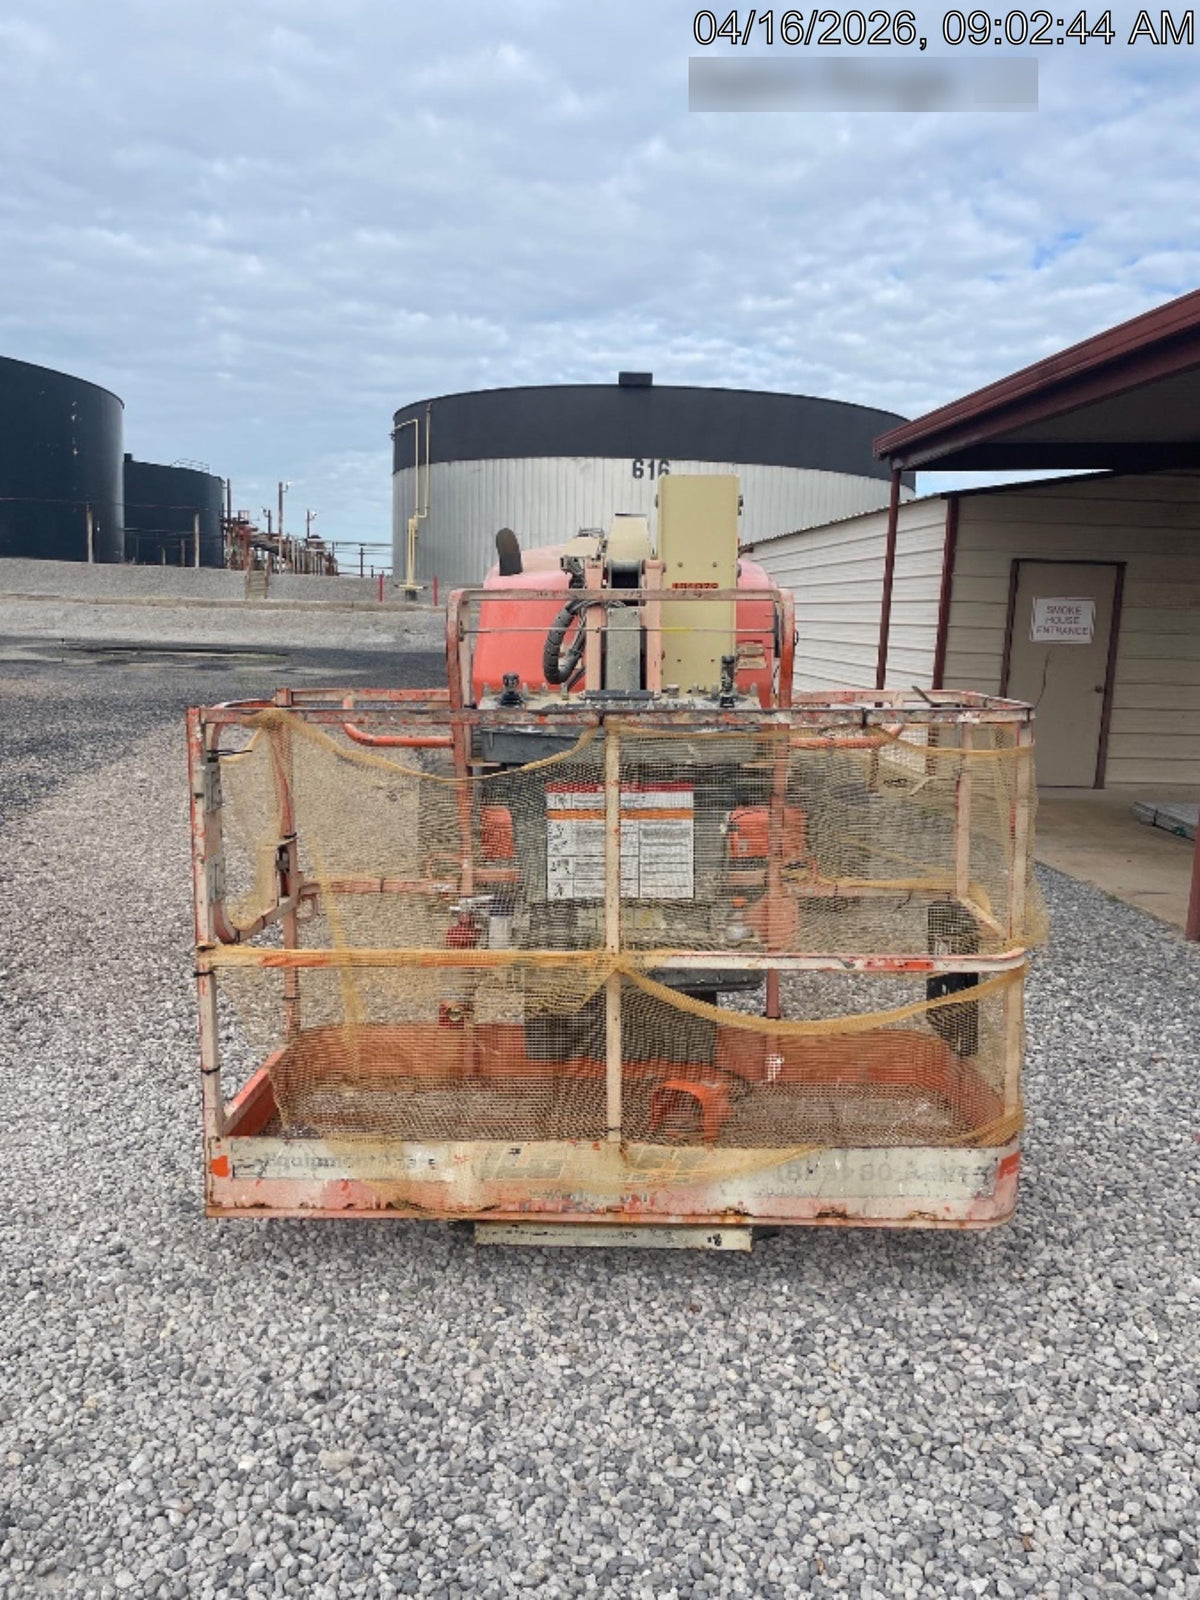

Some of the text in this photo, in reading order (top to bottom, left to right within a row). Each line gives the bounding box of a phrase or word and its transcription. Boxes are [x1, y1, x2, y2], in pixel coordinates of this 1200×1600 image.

[632, 457, 670, 480] 616
[1046, 605, 1083, 616] SMOKE
[1045, 616, 1080, 625] HOUSE
[1036, 625, 1089, 636] ENTRANCE
